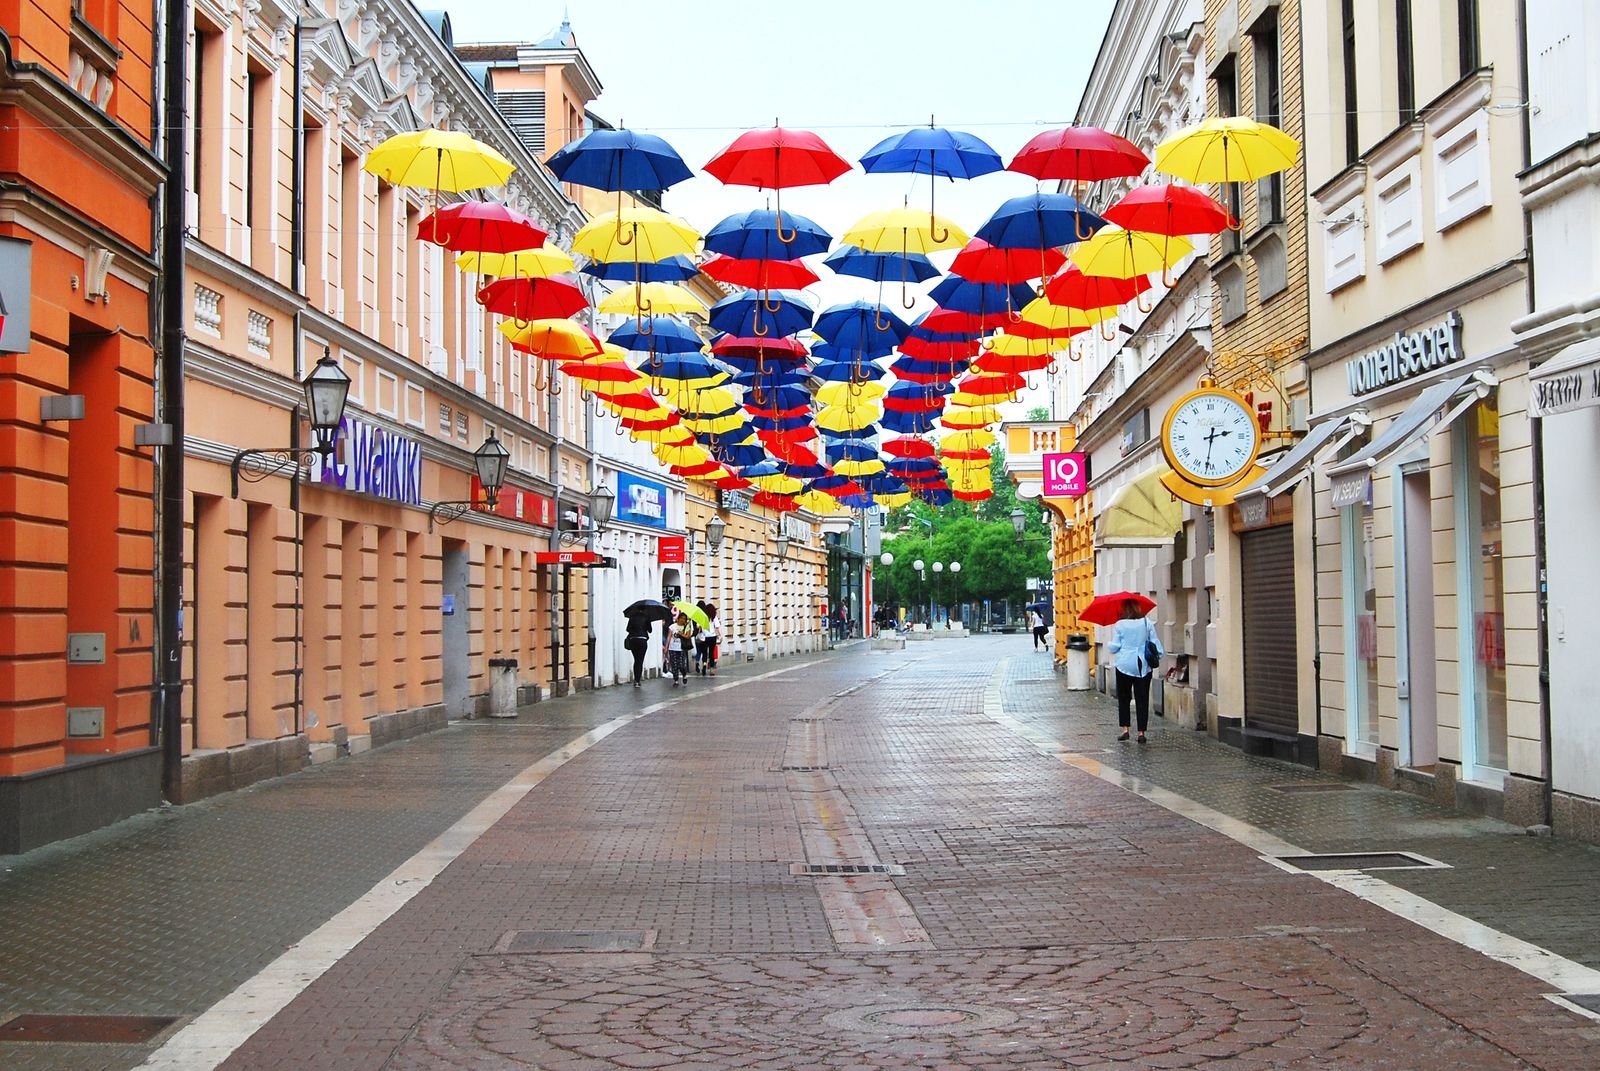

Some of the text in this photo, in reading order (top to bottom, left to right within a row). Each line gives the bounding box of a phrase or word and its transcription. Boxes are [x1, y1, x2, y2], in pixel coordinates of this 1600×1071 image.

[1345, 310, 1461, 396] women'secret
[1537, 374, 1582, 410] MANGO
[1050, 458, 1079, 484] IQ
[1051, 483, 1079, 491] MOBILE
